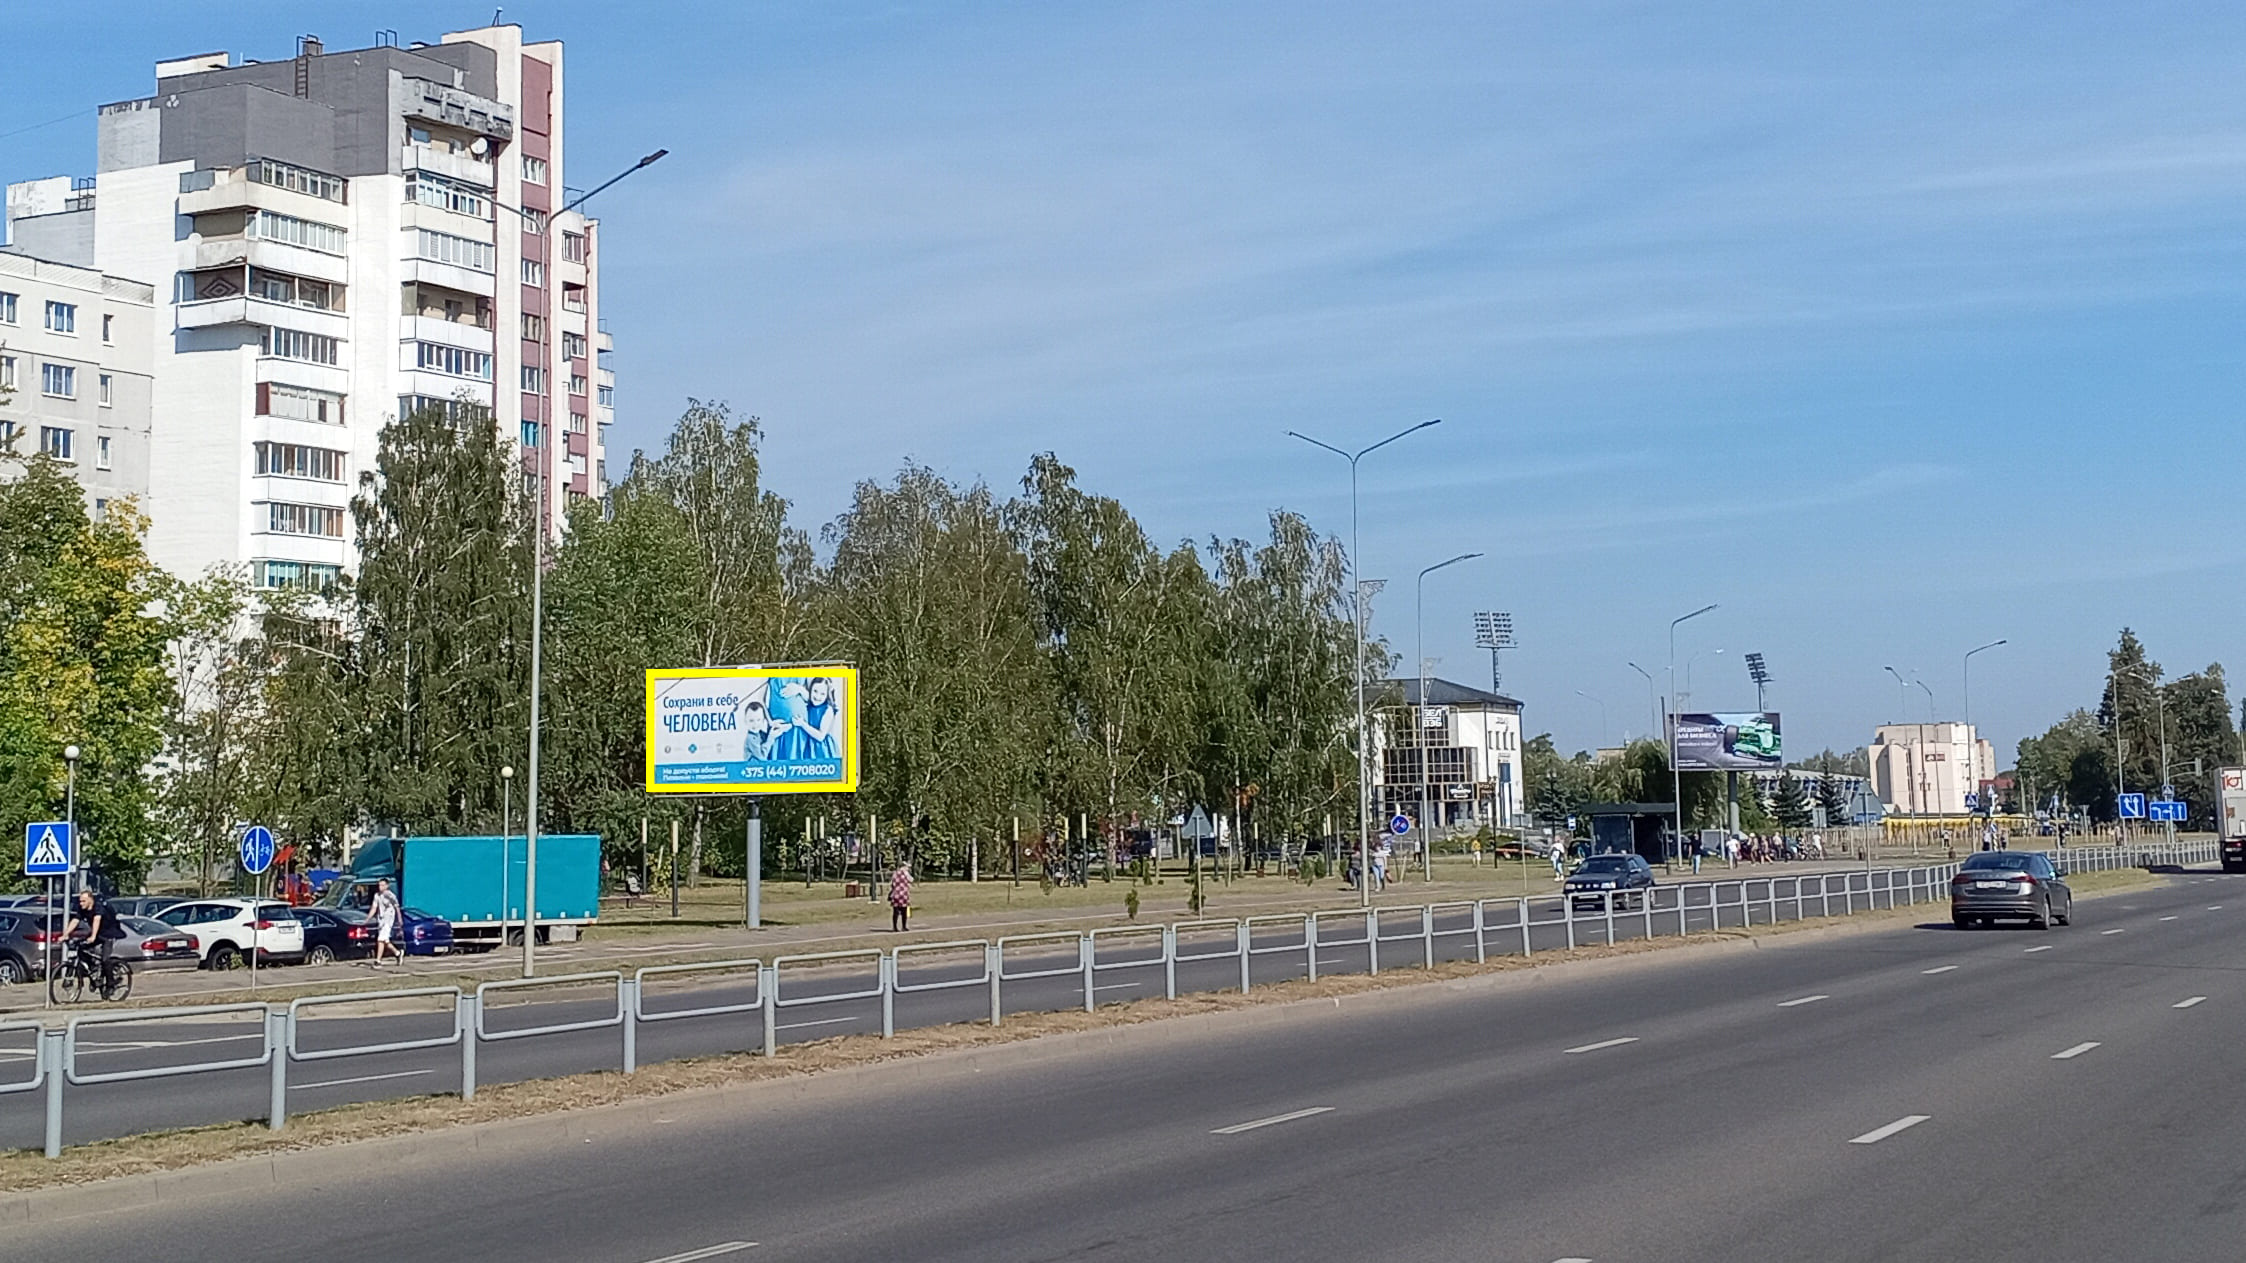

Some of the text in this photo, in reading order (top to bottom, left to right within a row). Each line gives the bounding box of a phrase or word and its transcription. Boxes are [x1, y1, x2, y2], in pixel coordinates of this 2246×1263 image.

[663, 693, 739, 711] Сохрани в себе
[663, 711, 737, 733] ЧЕЛОВЕКА
[740, 766, 764, 778] +375
[766, 765, 787, 778] (44)
[788, 764, 836, 777] 7708020
